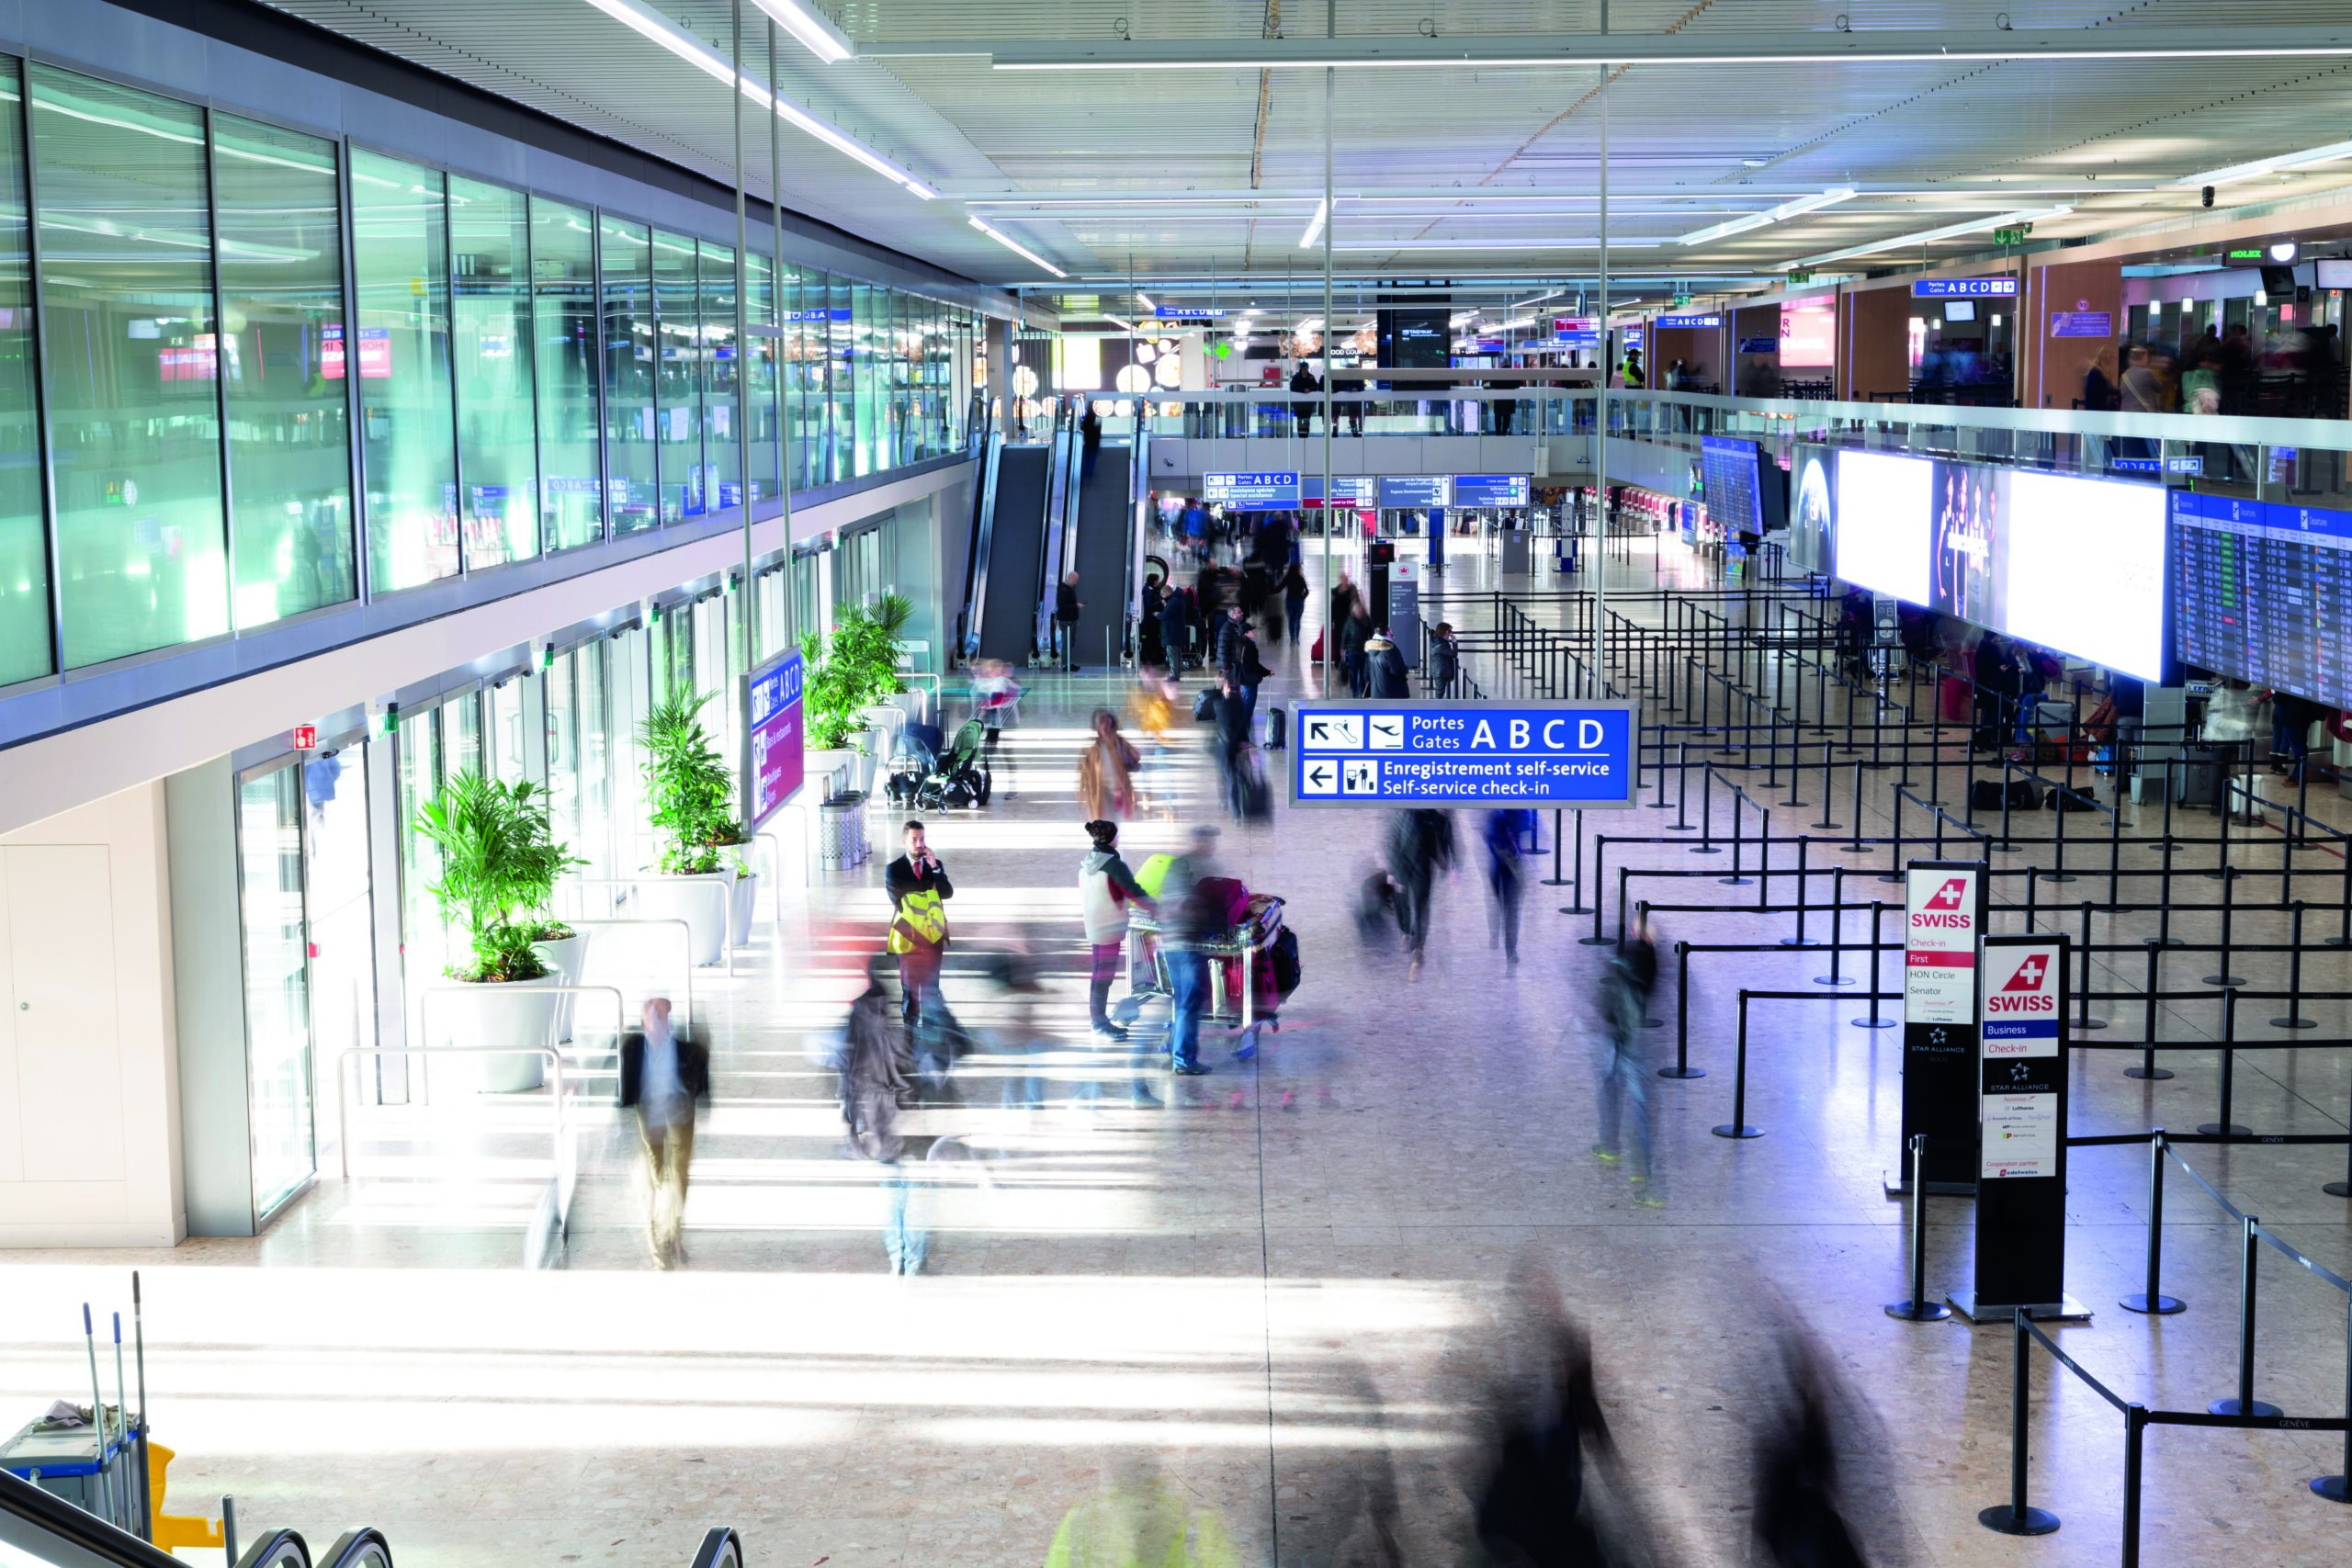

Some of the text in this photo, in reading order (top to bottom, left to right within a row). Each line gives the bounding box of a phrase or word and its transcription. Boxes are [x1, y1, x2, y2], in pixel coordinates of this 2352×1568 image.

[1948, 282, 1989, 293] A B C D
[1254, 476, 1291, 484] A B C D
[769, 676, 778, 691] Portes
[780, 663, 799, 704] A B C D
[1412, 716, 1464, 730] Portes
[1470, 719, 1604, 750] A B C D
[1412, 736, 1460, 750] Gates
[1384, 761, 1610, 778] Enregistrement self-service
[1384, 781, 1549, 795] Self-service check-in
[1911, 913, 1971, 929] SWISS
[1911, 938, 1946, 947] Check-in
[1910, 955, 1928, 964] First
[1932, 971, 1955, 979] Circle
[1910, 987, 1941, 995] Senator
[1988, 995, 2053, 1012] SWISS
[1987, 1025, 2027, 1035] Business
[1988, 1043, 2027, 1054] Check-in
[2278, 1419, 2311, 1428] GENÈVE
